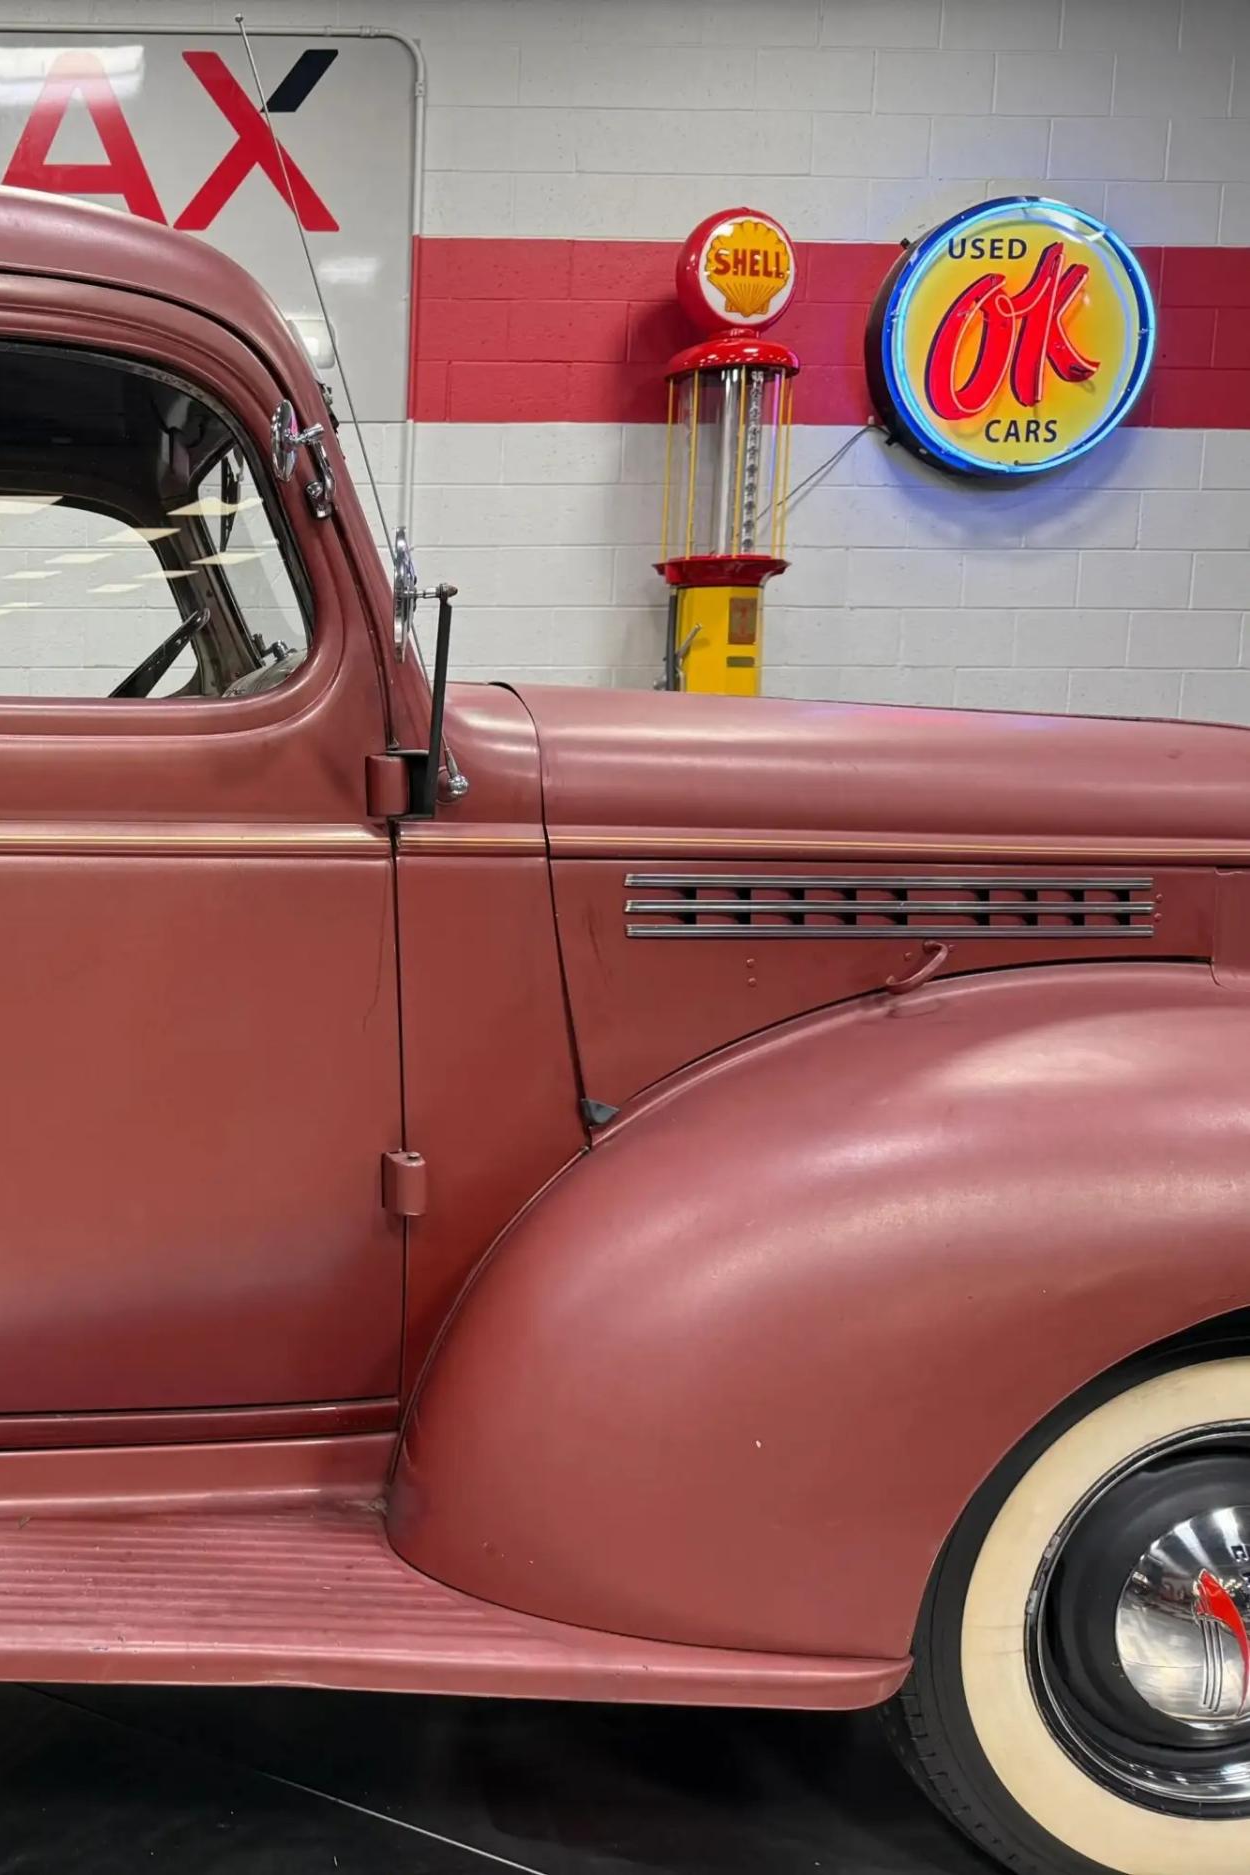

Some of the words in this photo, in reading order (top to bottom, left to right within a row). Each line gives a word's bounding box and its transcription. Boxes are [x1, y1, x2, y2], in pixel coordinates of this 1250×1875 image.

[947, 237, 1028, 260] USED
[713, 247, 785, 279] SHELL
[923, 241, 1101, 421] OK
[984, 419, 1058, 444] CARS
